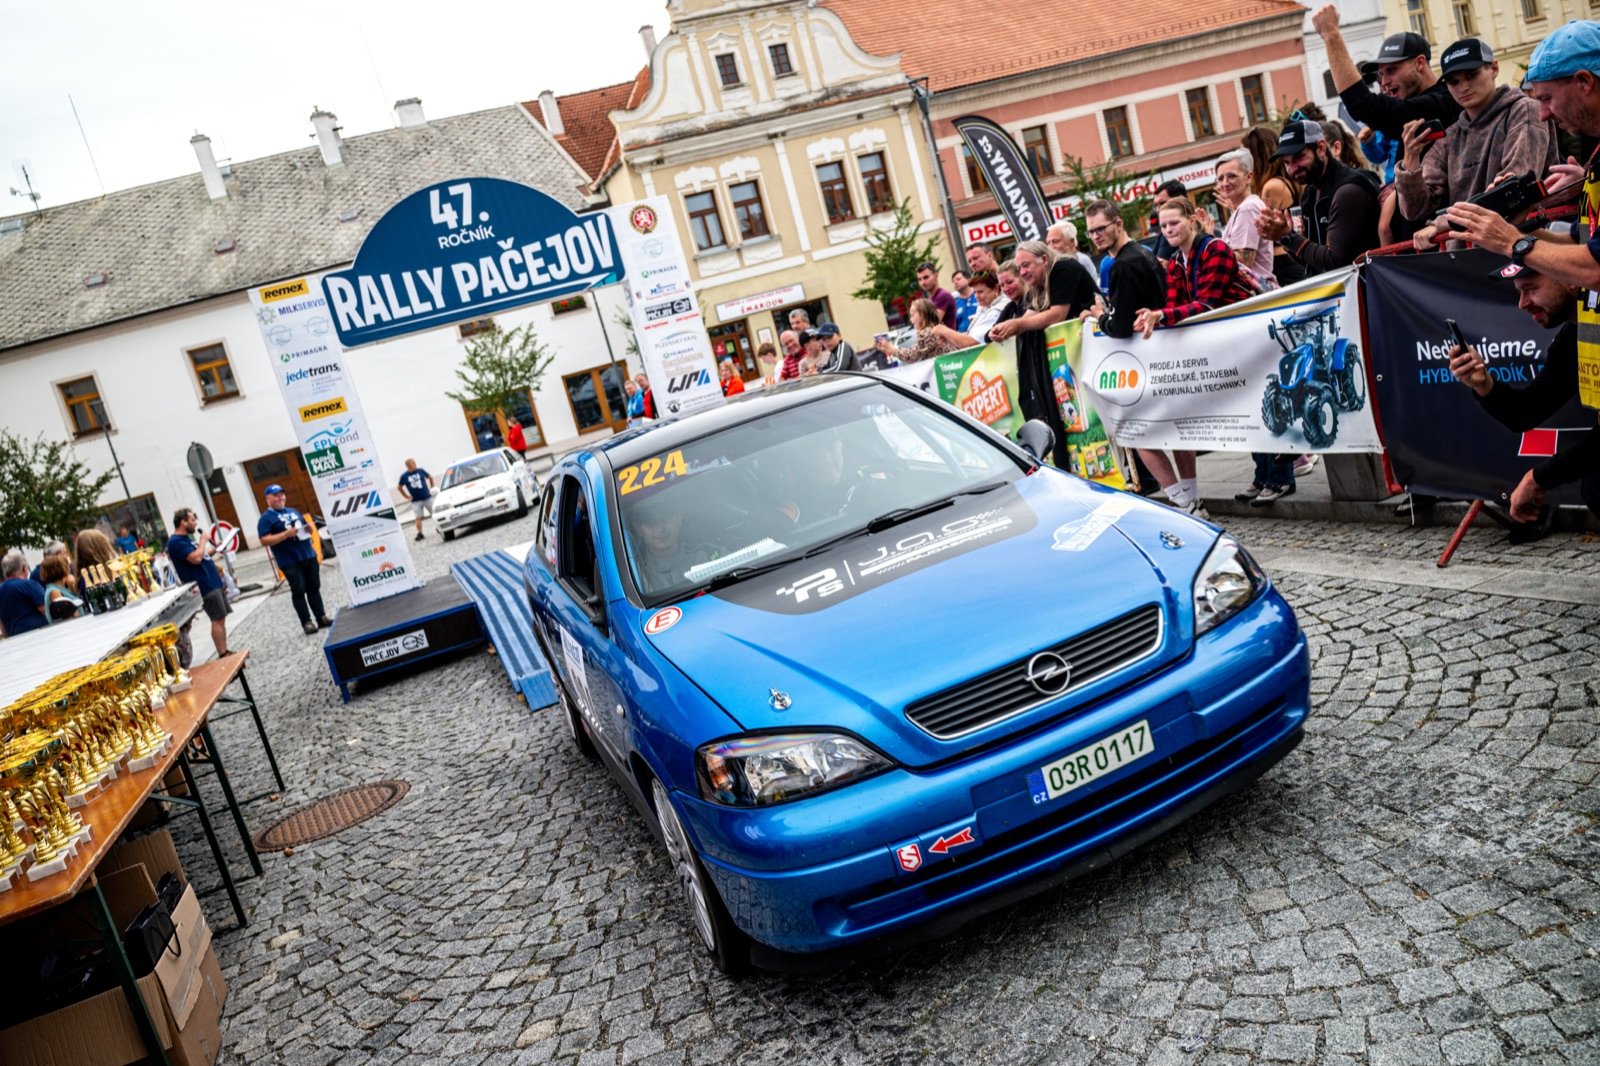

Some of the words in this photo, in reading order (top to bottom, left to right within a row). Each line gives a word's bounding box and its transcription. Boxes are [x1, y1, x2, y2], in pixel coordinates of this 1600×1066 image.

[1177, 167, 1217, 184] KOSMET
[428, 182, 490, 230] 47.
[437, 224, 495, 250] ROČNÍK
[325, 266, 446, 332] RALLY
[450, 213, 615, 304] PAČEJOV
[277, 298, 327, 317] MILKSERVIS
[1149, 360, 1175, 373] PRODEJ
[1182, 357, 1209, 369] SERVIS
[1199, 368, 1239, 381] STAVEBNÍ
[1492, 363, 1529, 384] ODÍK
[1099, 369, 1139, 390] ARBO
[1158, 383, 1203, 397] KOMUNÁLNÍ
[1203, 380, 1247, 395] TECHNIKY
[962, 379, 1005, 420] EXPERT
[618, 450, 689, 497] 224
[352, 564, 406, 589] forestina
[653, 610, 673, 630] E
[363, 647, 401, 666] PAČEJOV
[1032, 790, 1048, 805] CZ
